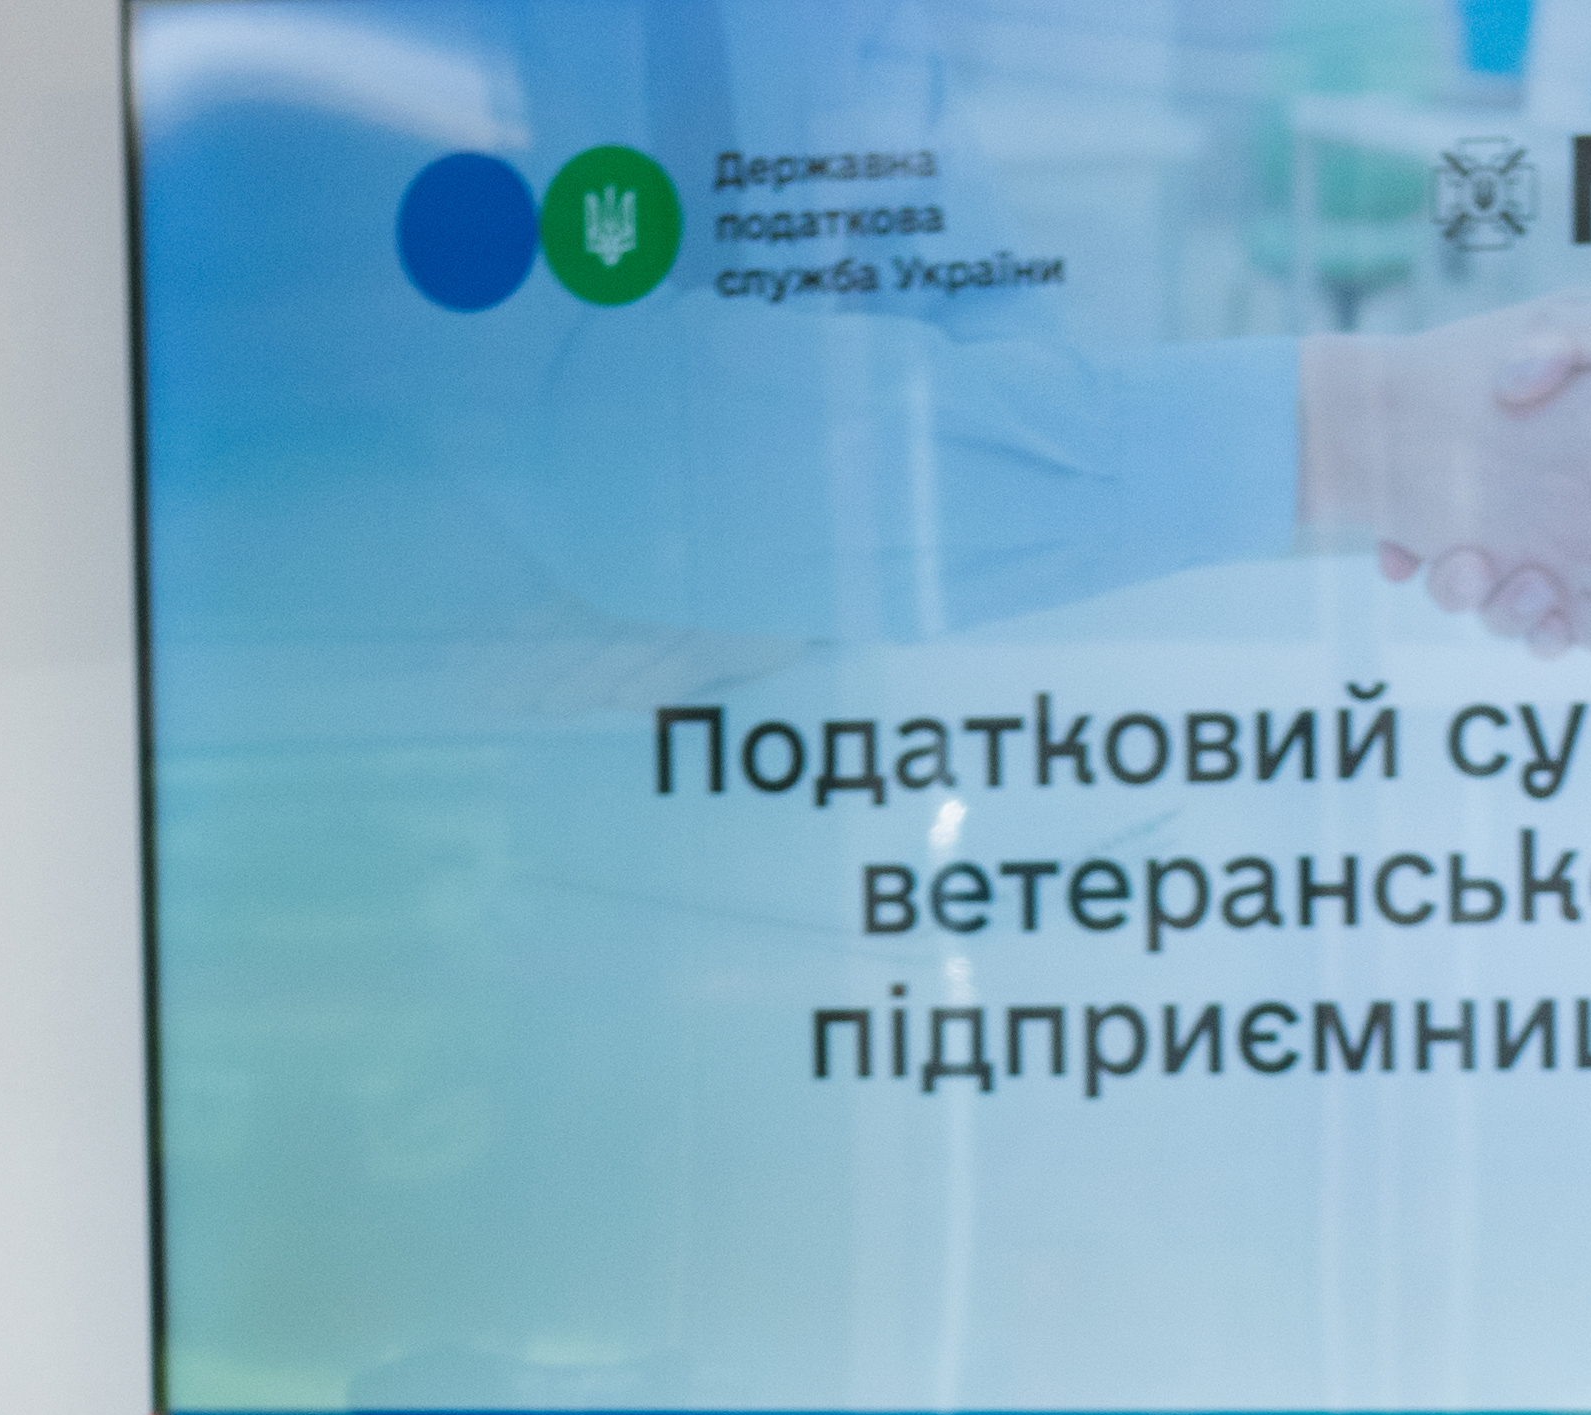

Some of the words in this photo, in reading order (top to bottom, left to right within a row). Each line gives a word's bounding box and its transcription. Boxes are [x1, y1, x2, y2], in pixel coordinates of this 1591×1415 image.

[712, 148, 937, 192] Державна
[713, 203, 945, 244] податкова
[714, 257, 879, 303] служба
[895, 250, 1065, 296] України
[654, 682, 1400, 808] Податковий
